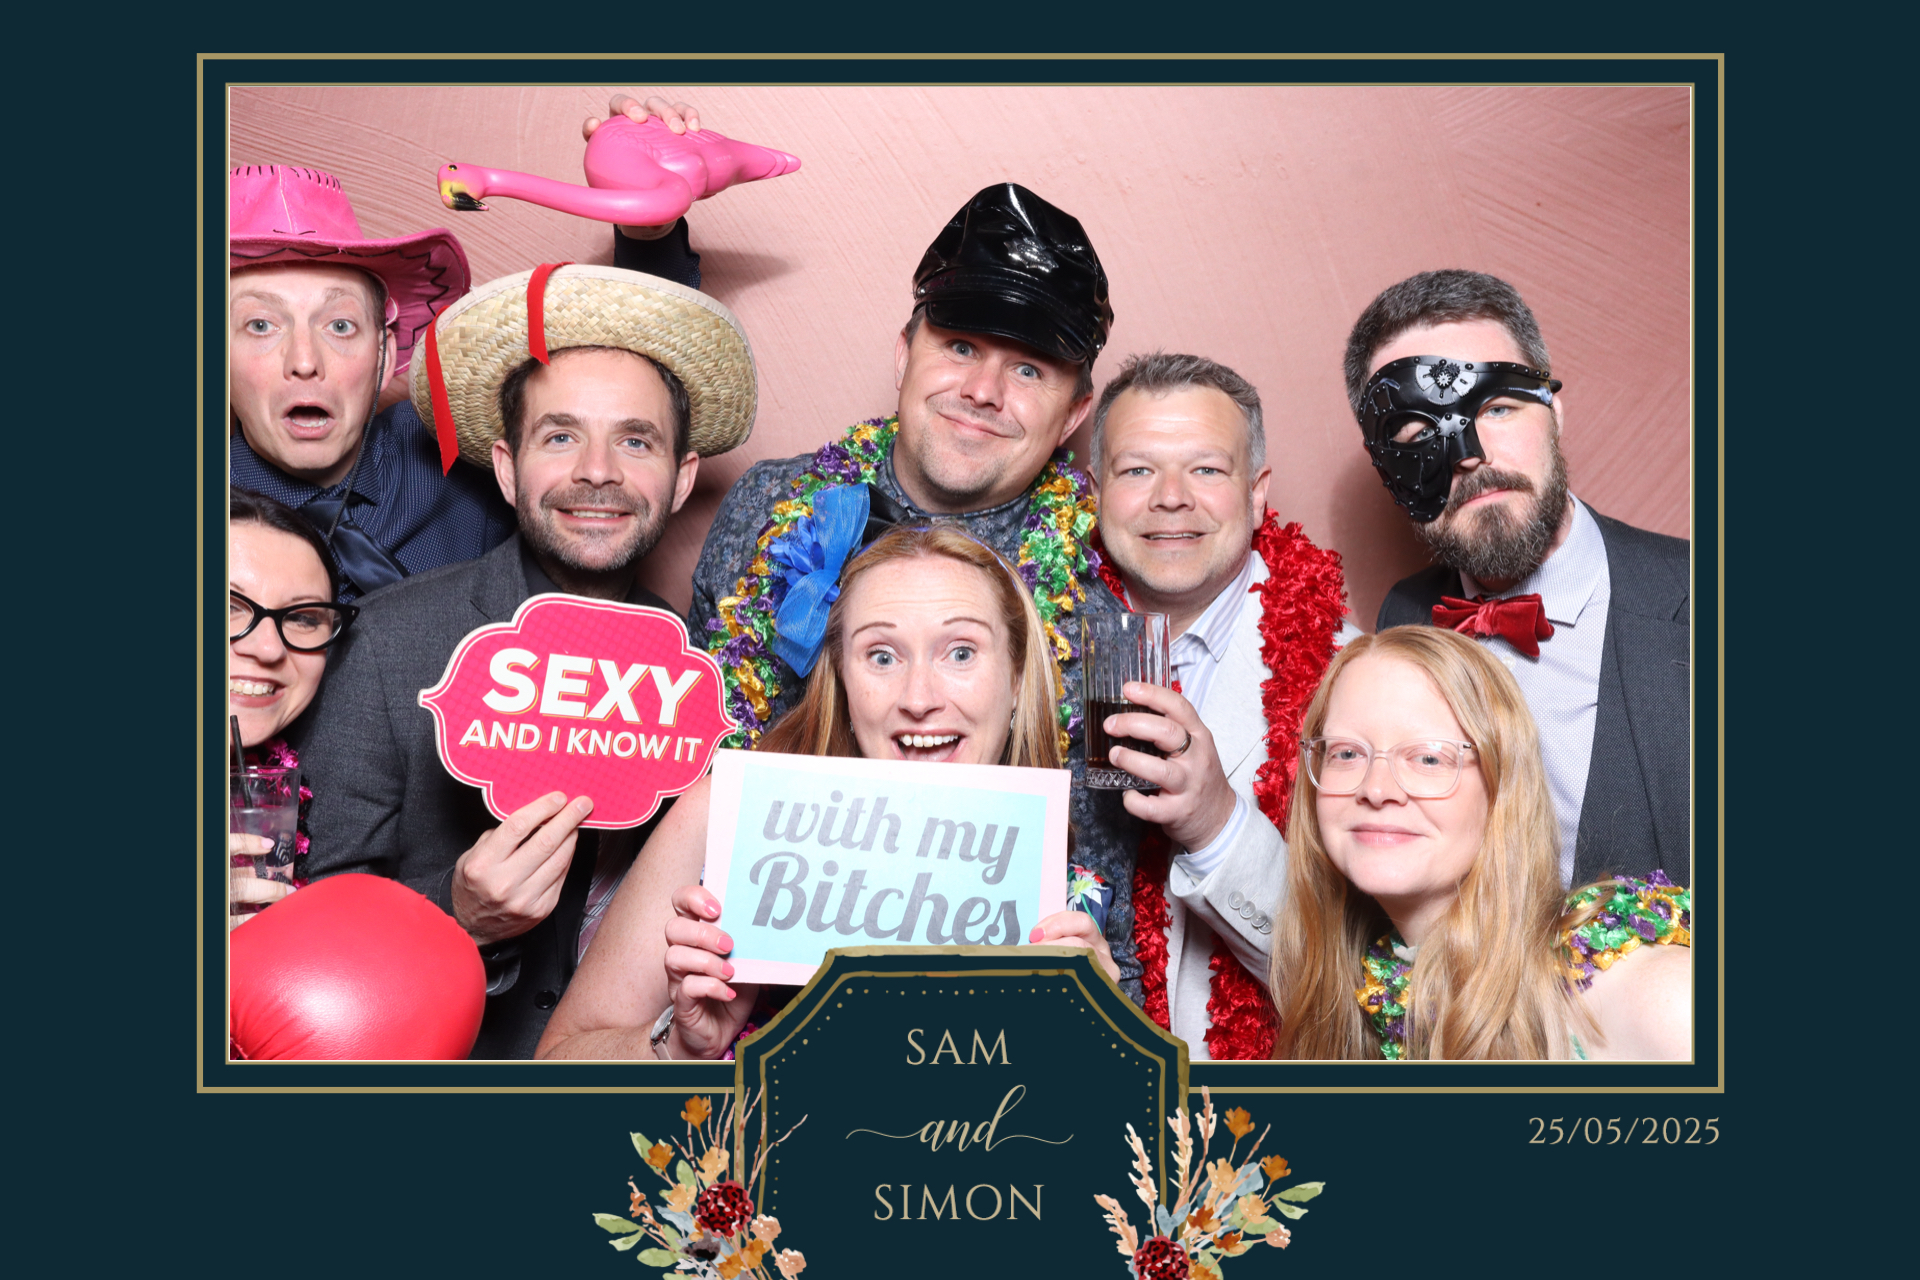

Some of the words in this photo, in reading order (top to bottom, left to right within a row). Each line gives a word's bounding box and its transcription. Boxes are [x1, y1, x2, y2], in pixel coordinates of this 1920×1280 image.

[482, 648, 704, 726] SEXY
[459, 720, 541, 752] AND
[548, 726, 560, 754] I
[566, 727, 670, 760] KNOW
[674, 736, 704, 764] IT
[762, 789, 900, 854] with
[915, 816, 1020, 885] my
[748, 851, 1021, 946] Bitches
